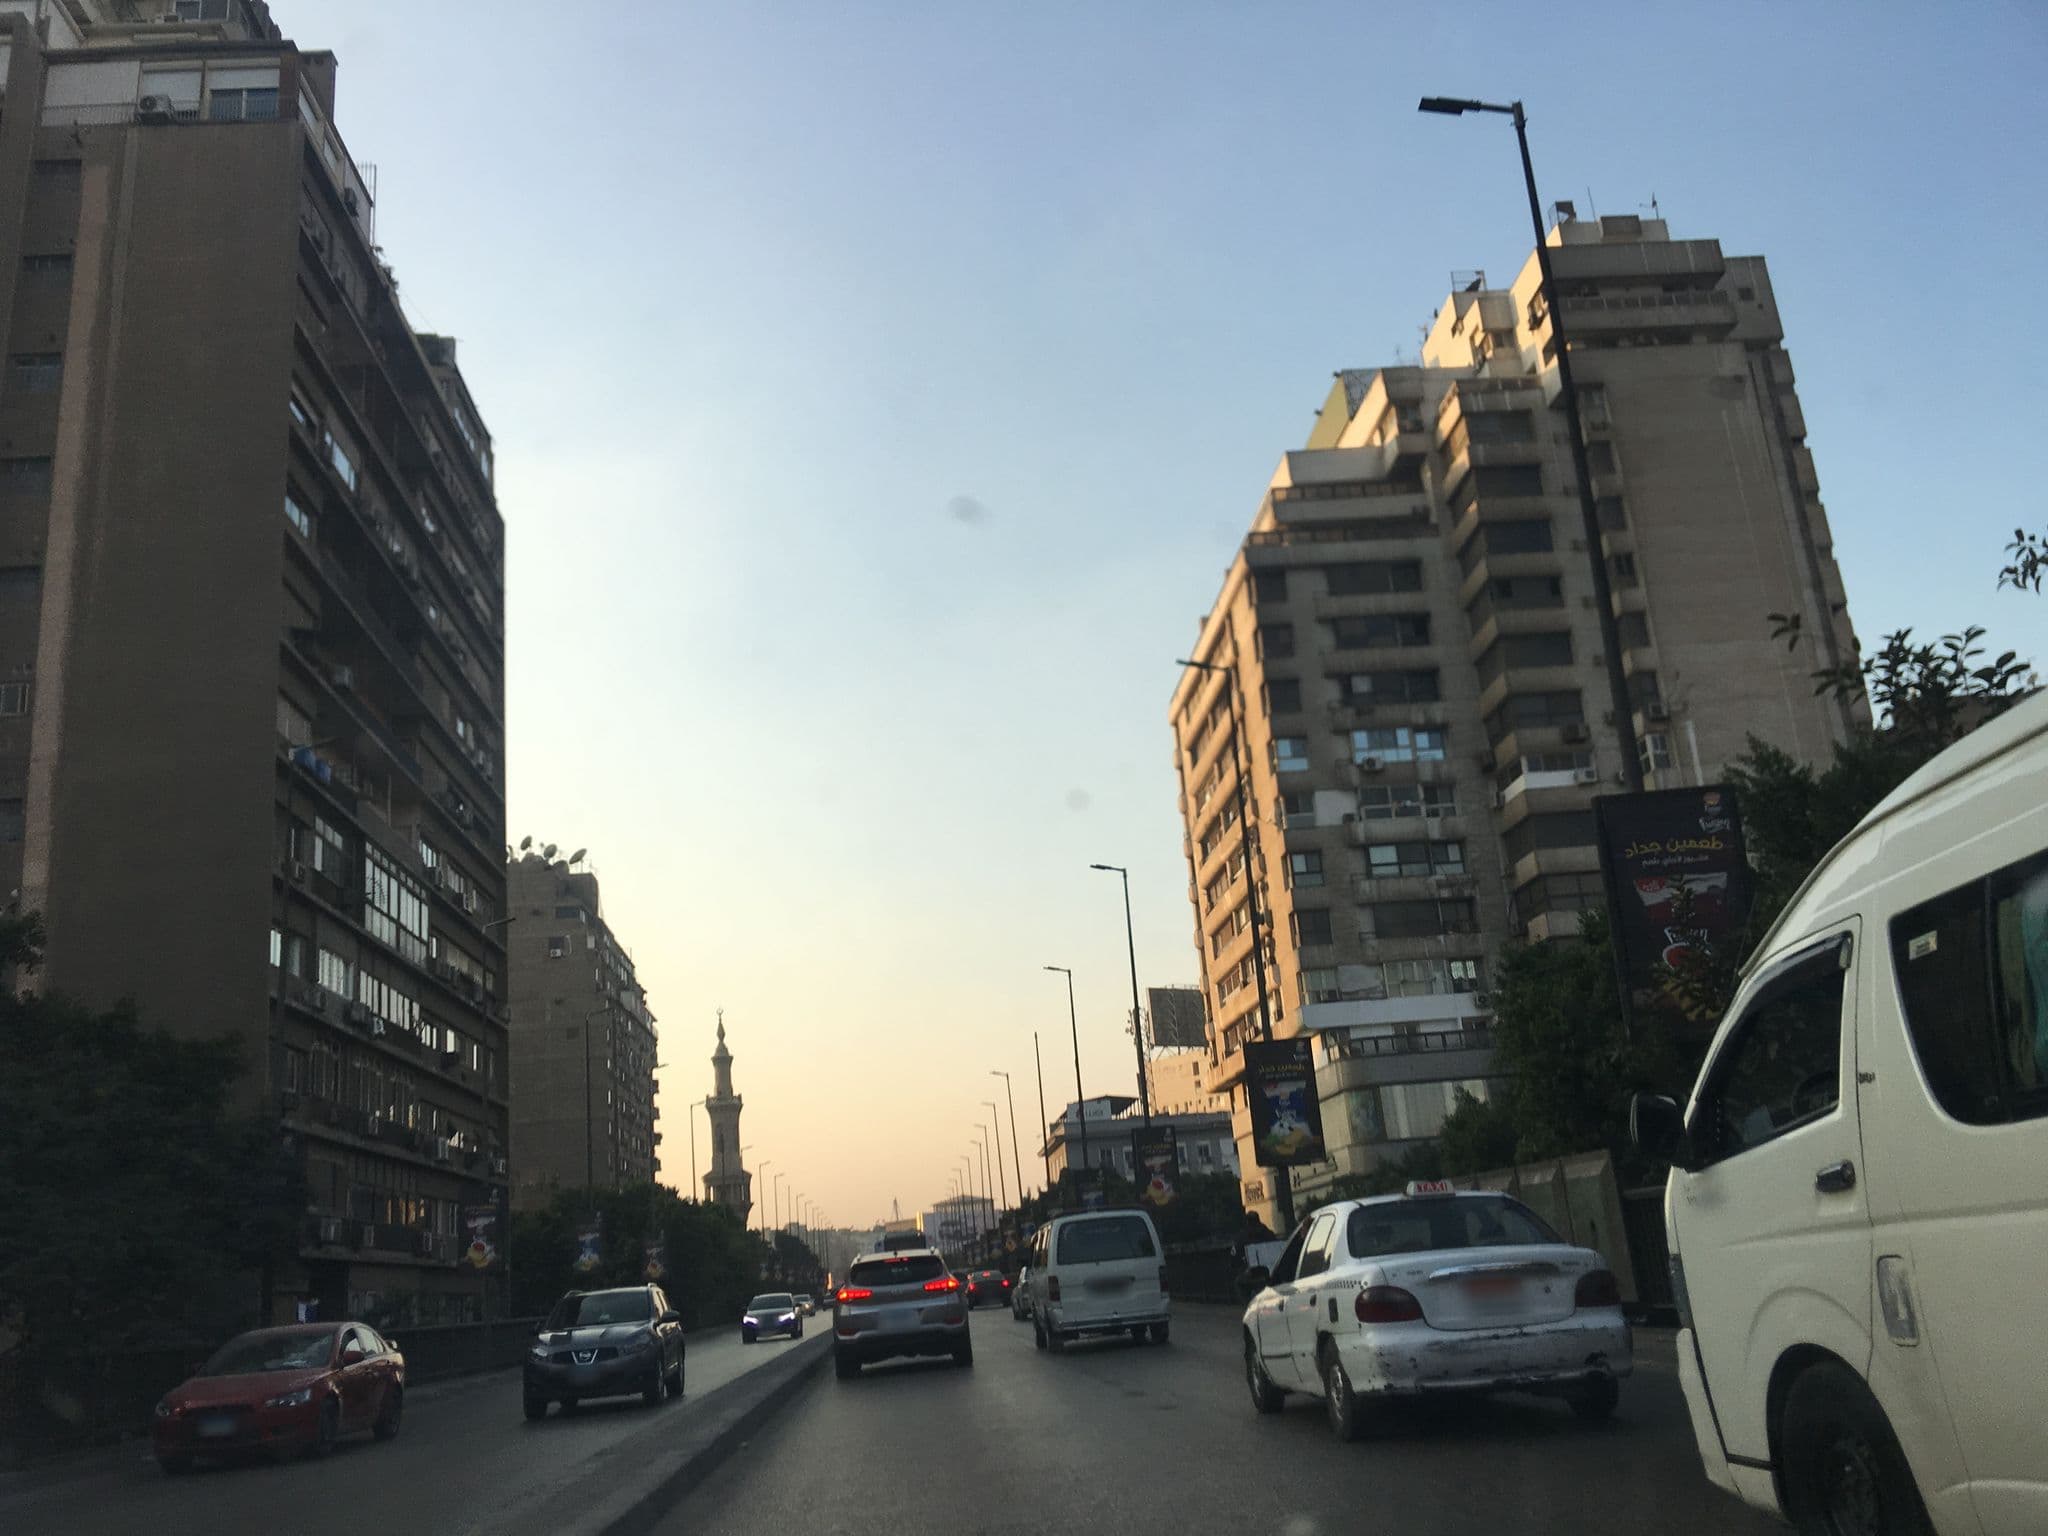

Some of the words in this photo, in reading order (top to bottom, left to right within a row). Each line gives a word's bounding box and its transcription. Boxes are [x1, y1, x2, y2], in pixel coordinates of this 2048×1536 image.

[1624, 840, 1663, 859] جداد
[1666, 836, 1723, 853] طعمين
[1416, 1181, 1448, 1193] TAXI
